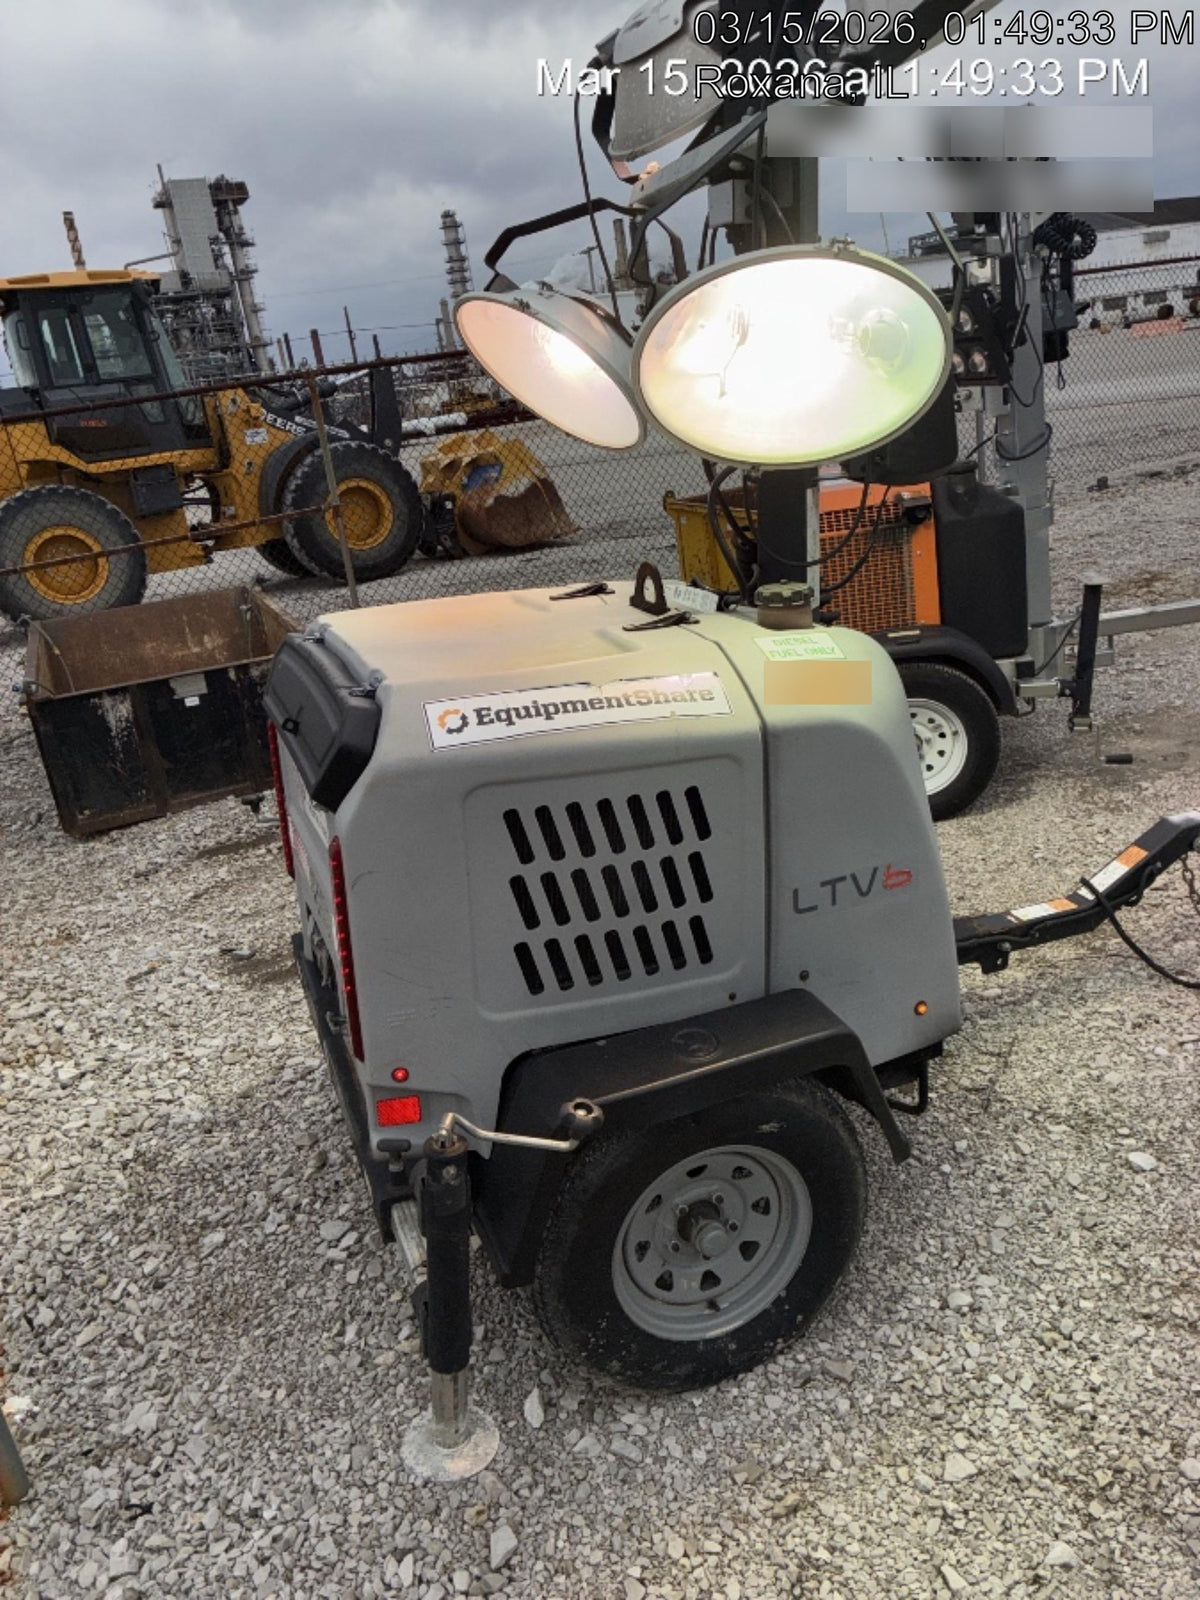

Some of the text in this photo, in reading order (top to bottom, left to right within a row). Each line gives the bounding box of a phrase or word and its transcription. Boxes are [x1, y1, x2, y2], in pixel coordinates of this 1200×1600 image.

[772, 635, 818, 647] DIESEL
[767, 646, 836, 659] FUEL ONLY
[473, 687, 716, 727] EquipmentShare
